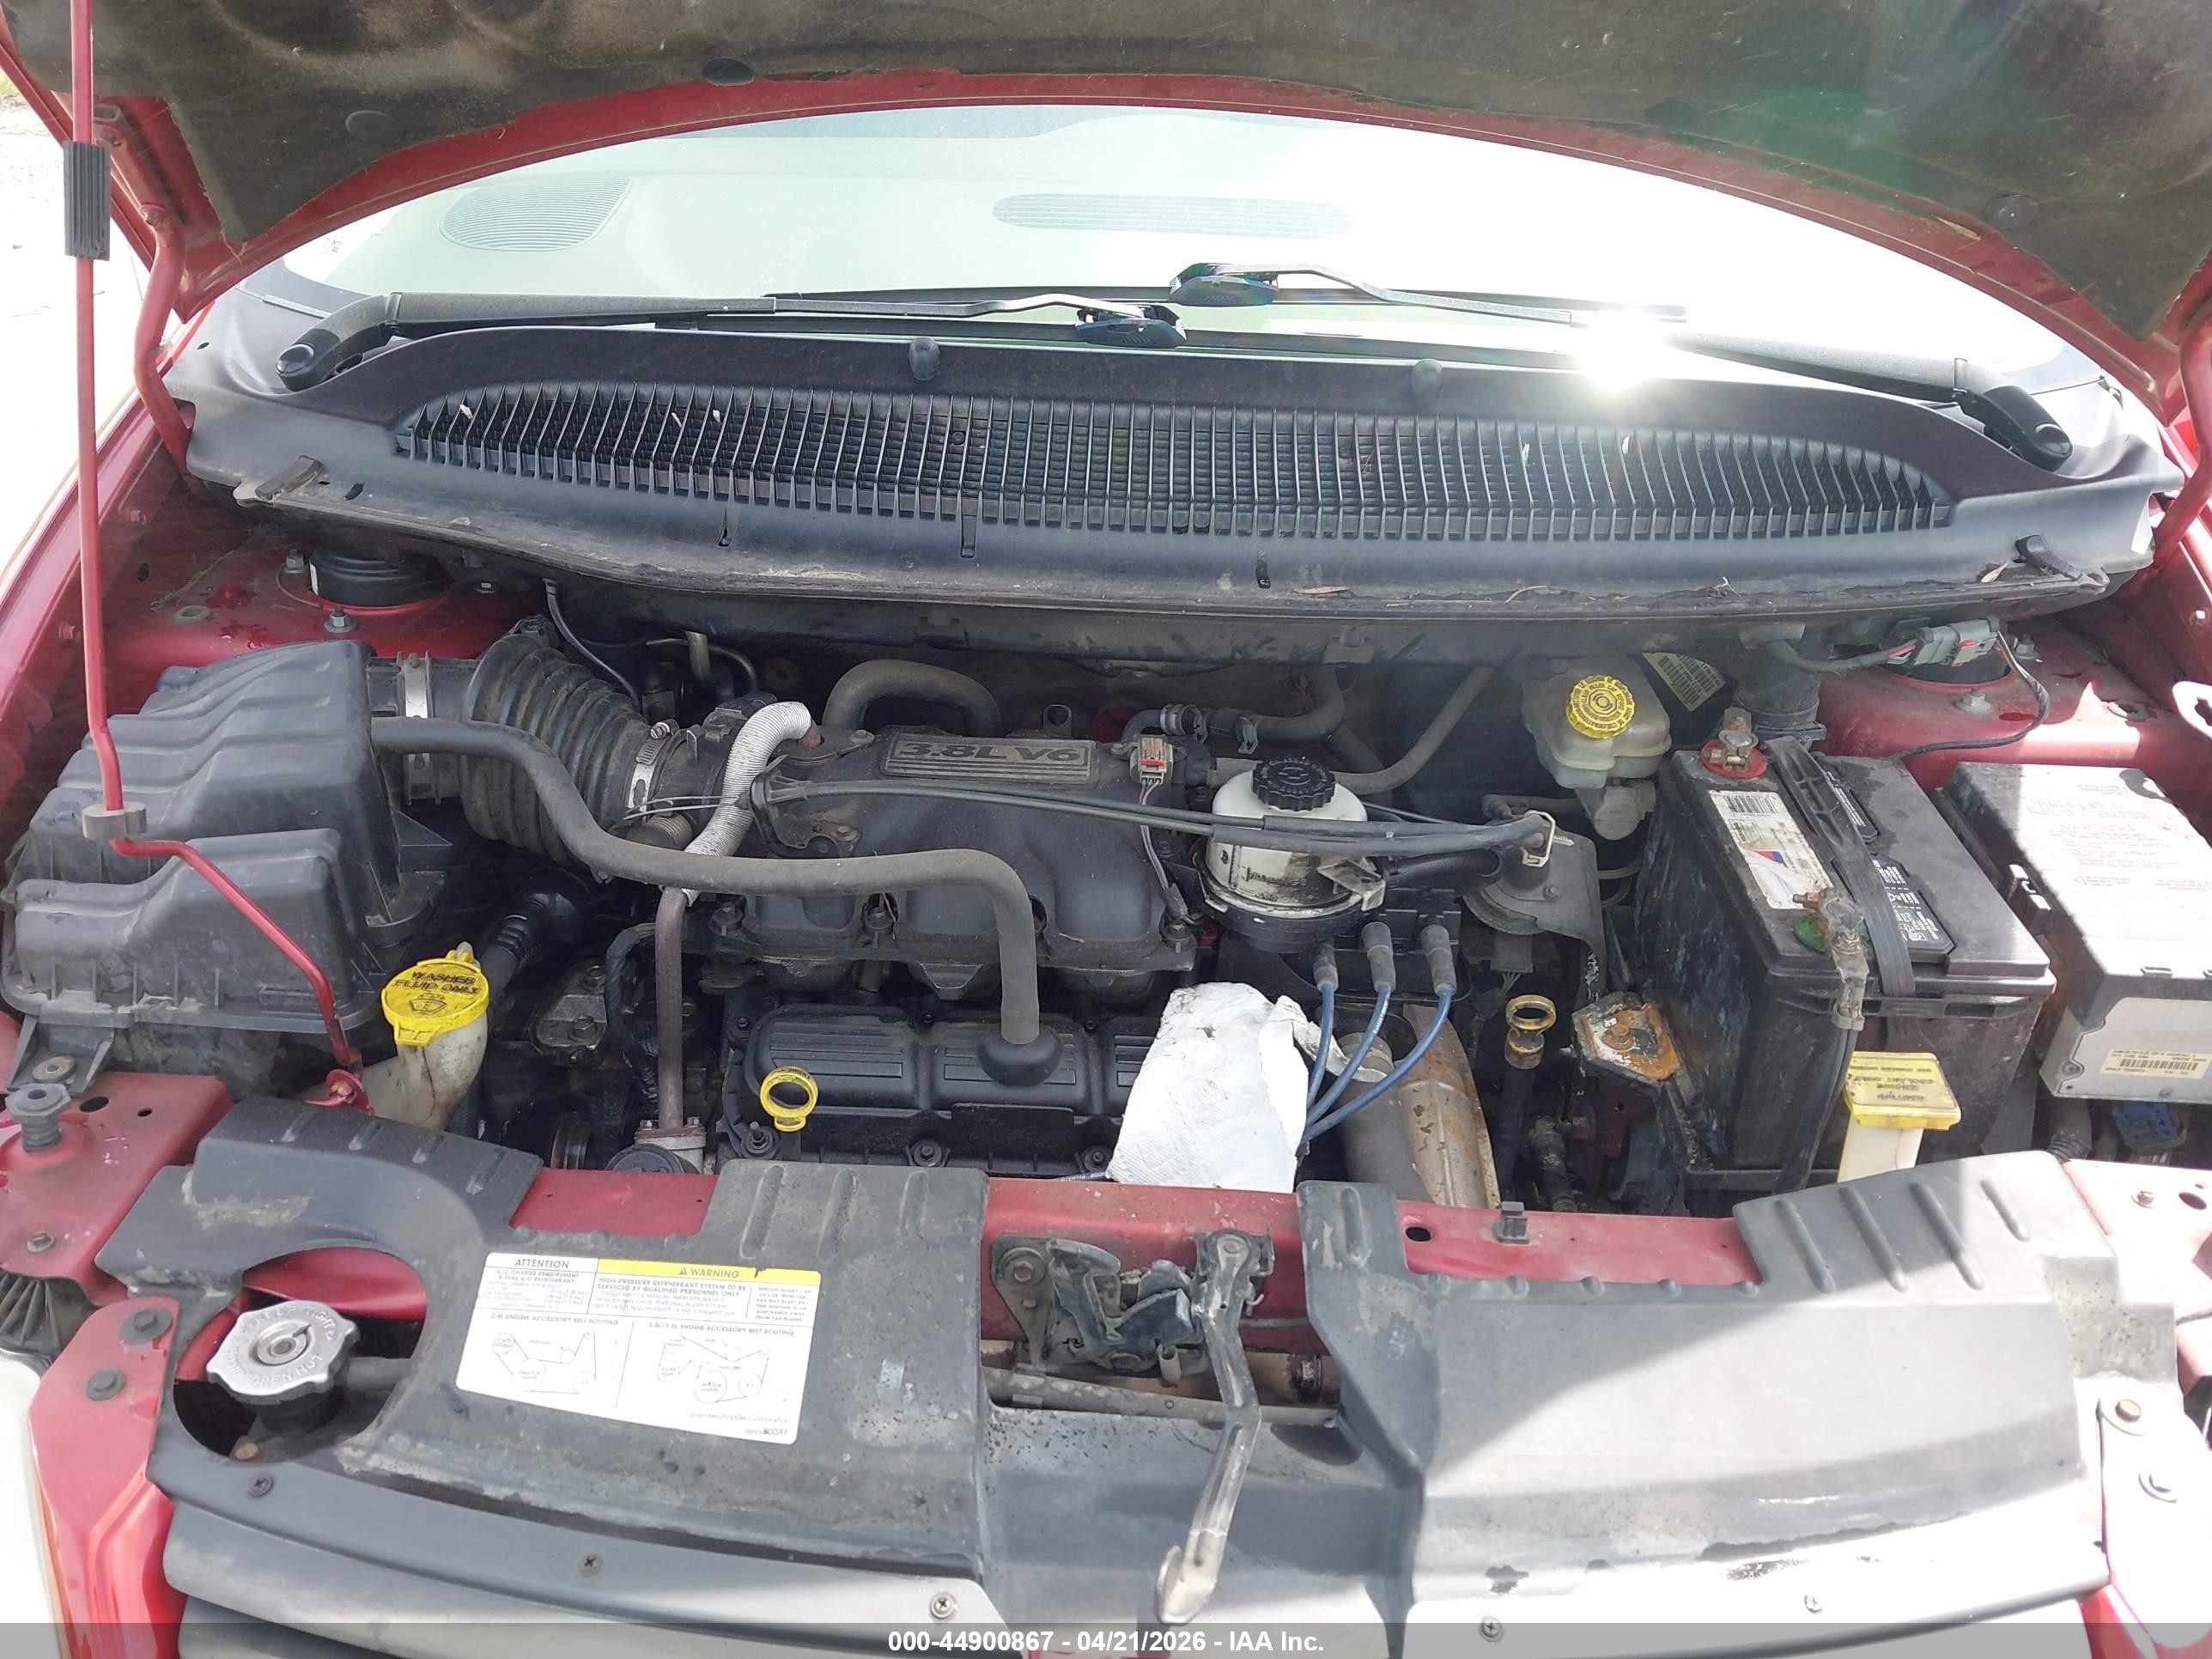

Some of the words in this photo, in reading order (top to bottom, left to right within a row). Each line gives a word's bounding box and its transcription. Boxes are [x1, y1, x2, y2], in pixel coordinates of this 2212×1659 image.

[899, 743, 1007, 759] 3.8L
[1016, 746, 1079, 762] V6
[412, 971, 476, 985] WASHER
[394, 979, 438, 991] FLUID
[441, 984, 479, 995] ONLY
[514, 1258, 569, 1269] ATTENTION
[690, 1267, 740, 1279] WARNING
[296, 1354, 324, 1376] HOT
